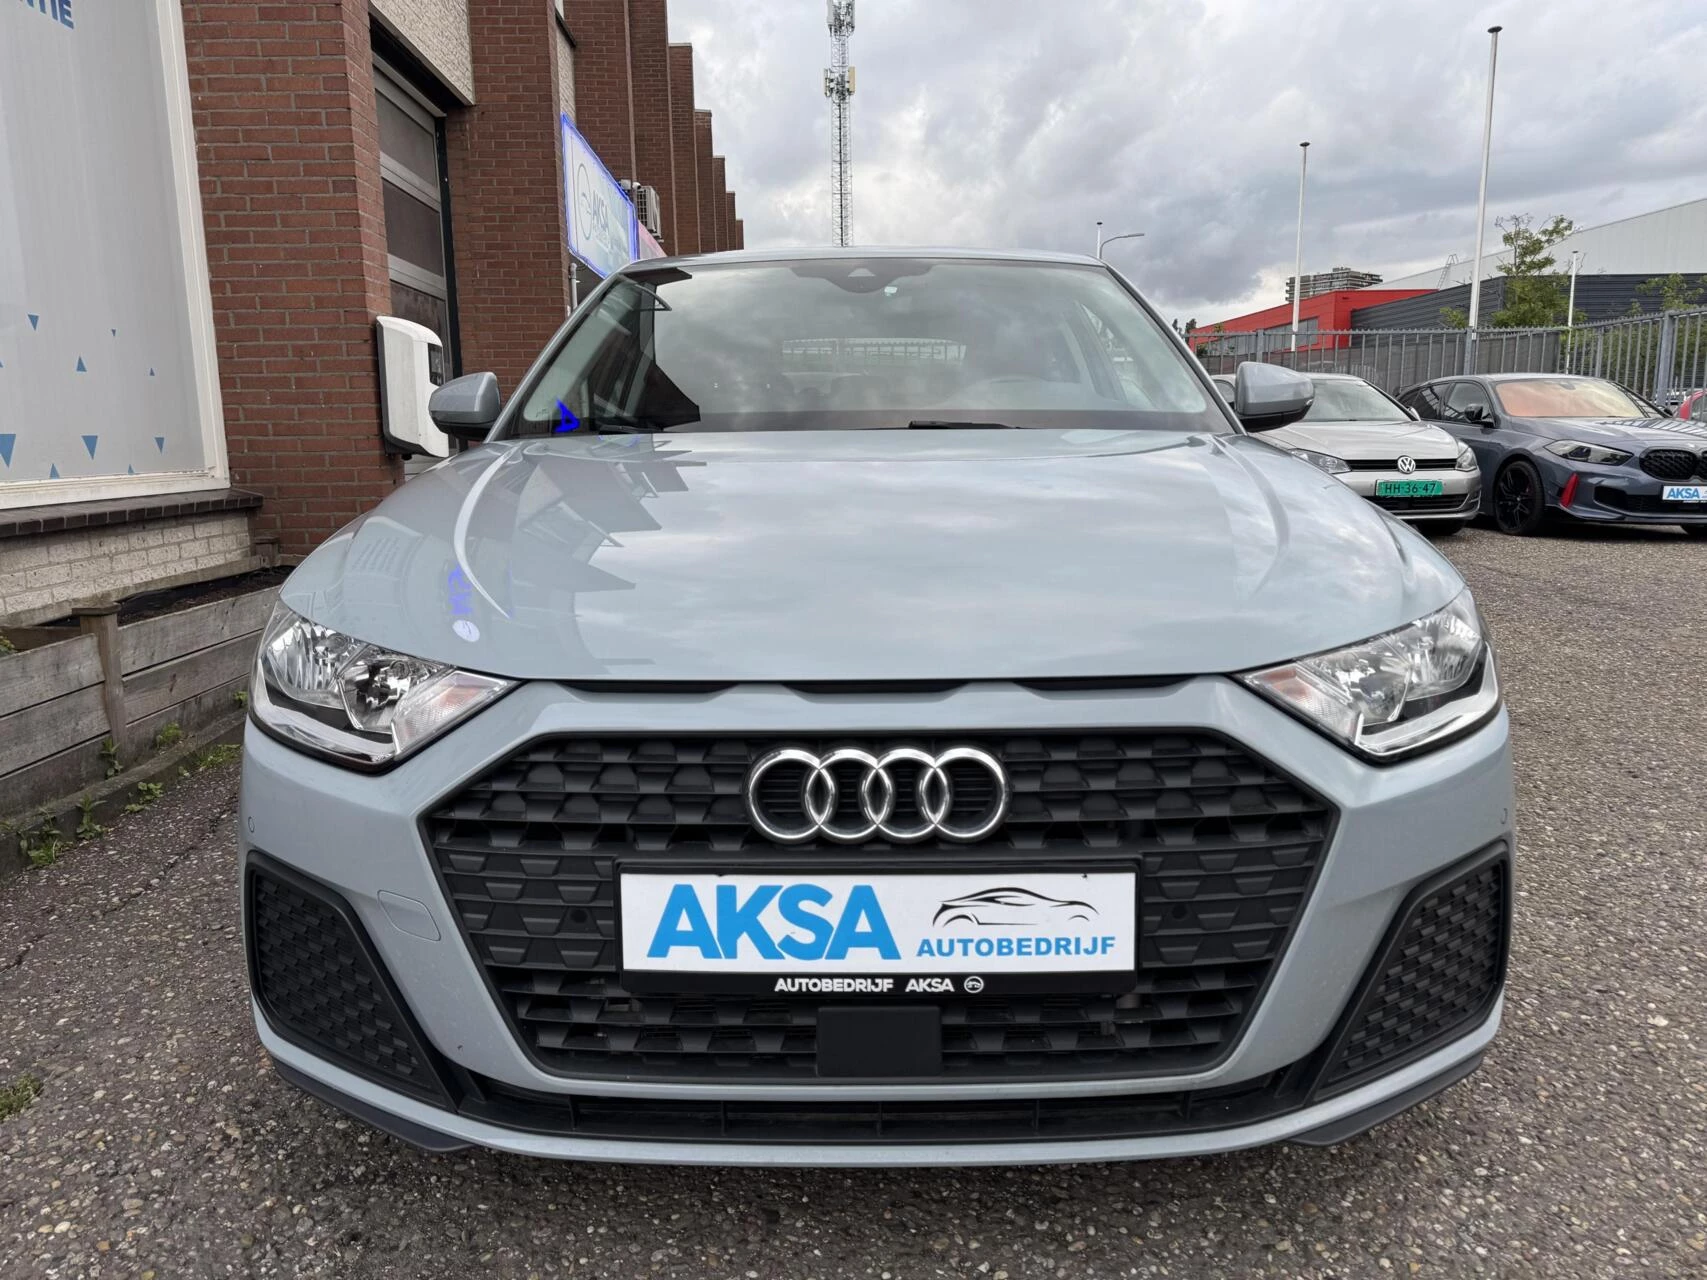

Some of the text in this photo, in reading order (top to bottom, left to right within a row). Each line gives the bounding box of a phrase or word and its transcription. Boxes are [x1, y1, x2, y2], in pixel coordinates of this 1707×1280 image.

[1385, 483, 1436, 494] HH-36-47
[1666, 487, 1700, 499] AKSA
[647, 884, 902, 961] AKSA
[916, 936, 1116, 957] AUTOBEDRIJF
[774, 978, 955, 993] AUTOBEDRIJF AKSA
